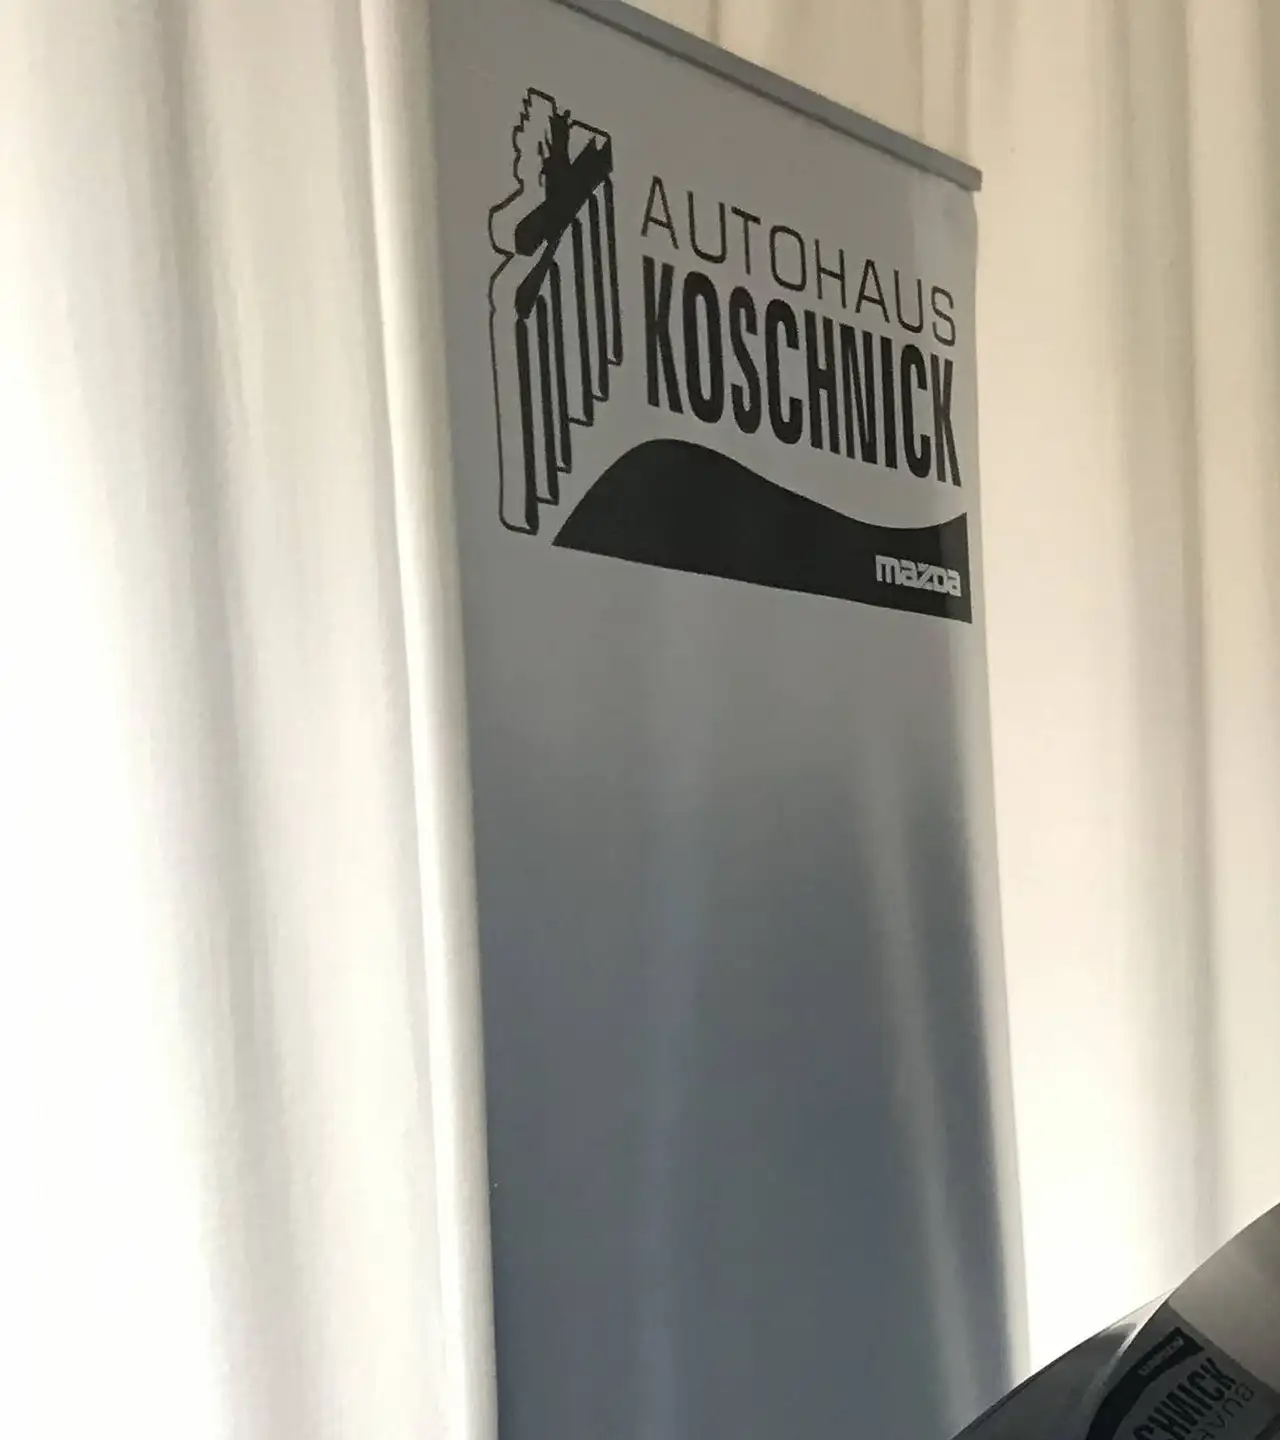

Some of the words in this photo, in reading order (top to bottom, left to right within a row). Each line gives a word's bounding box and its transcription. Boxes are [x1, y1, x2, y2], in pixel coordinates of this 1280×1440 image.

[641, 175, 956, 347] AUTOHAUS
[643, 255, 961, 487] KOSCHNICK
[875, 554, 961, 598] mazda
